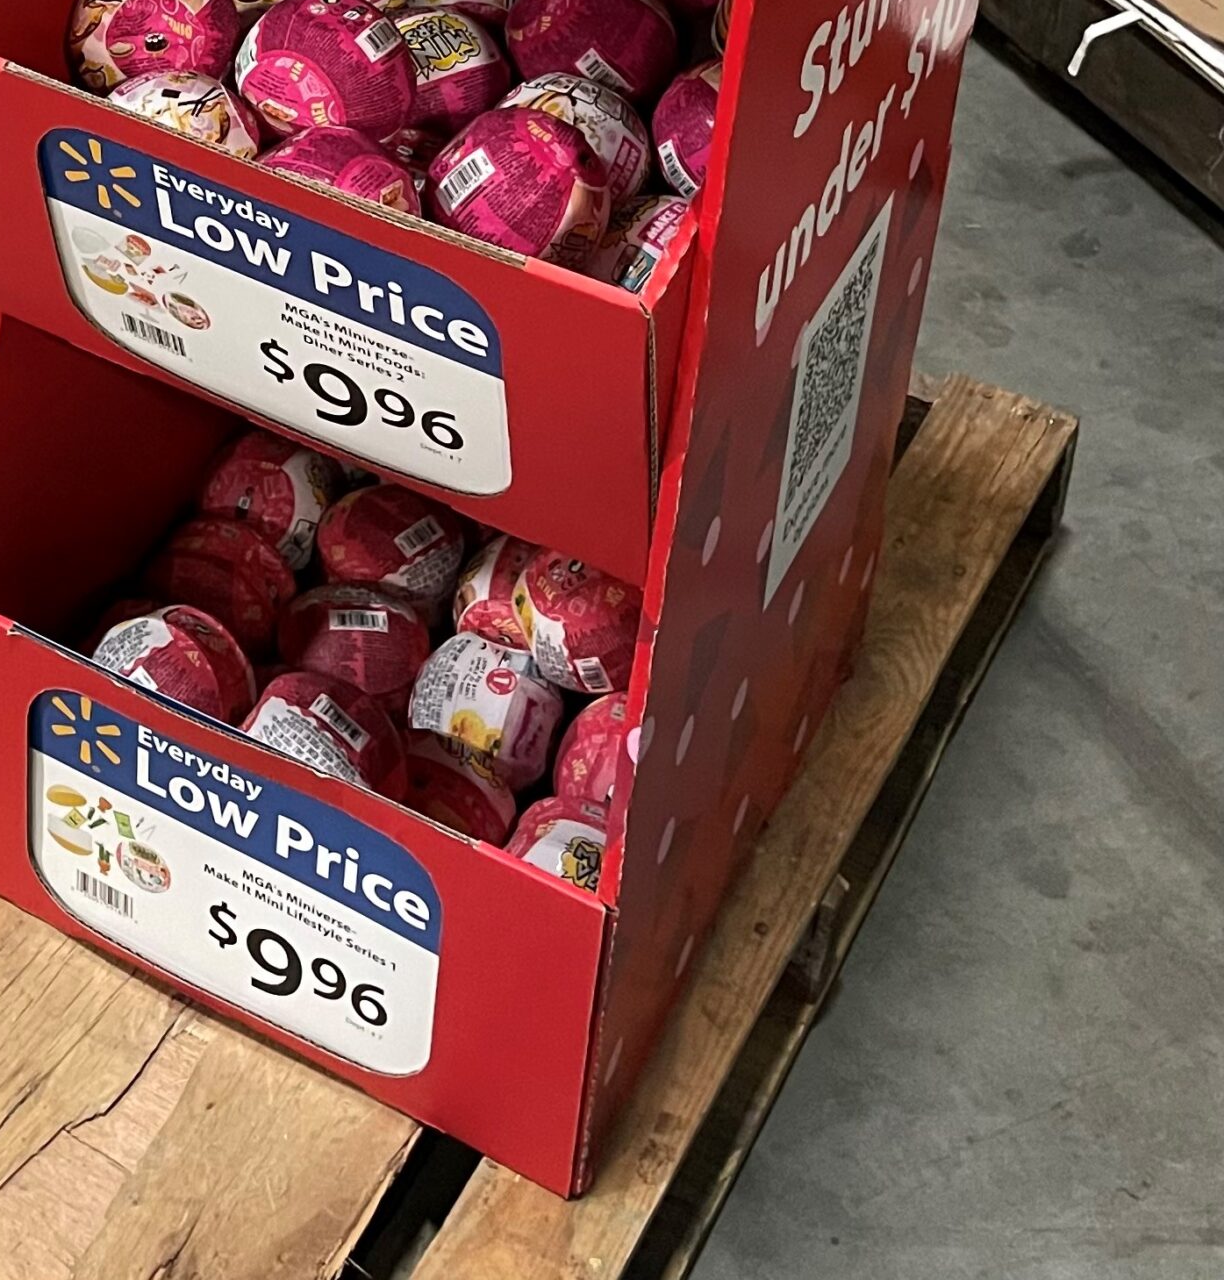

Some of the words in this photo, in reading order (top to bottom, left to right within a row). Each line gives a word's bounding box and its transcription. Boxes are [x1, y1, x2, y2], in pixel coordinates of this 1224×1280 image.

[152, 164, 290, 238] Everyday
[755, 84, 896, 331] under
[156, 188, 292, 277] Low
[311, 251, 489, 357] Price
[281, 313, 320, 336] Make
[324, 330, 334, 342] It
[338, 337, 371, 357] Mini
[375, 352, 426, 379] Foods:
[285, 302, 330, 328] MGA's
[303, 334, 343, 357] Diner
[347, 353, 392, 377] Series
[396, 373, 405, 383] 2
[137, 725, 263, 801] Everyday
[136, 747, 260, 839] Low
[276, 815, 430, 931] Price
[204, 864, 239, 889] Make
[242, 883, 252, 896] It
[255, 890, 283, 912] Mini
[286, 906, 342, 942] Lifestyle
[346, 936, 386, 966] Series
[390, 961, 397, 972] 1
[242, 870, 283, 897] MGA's
